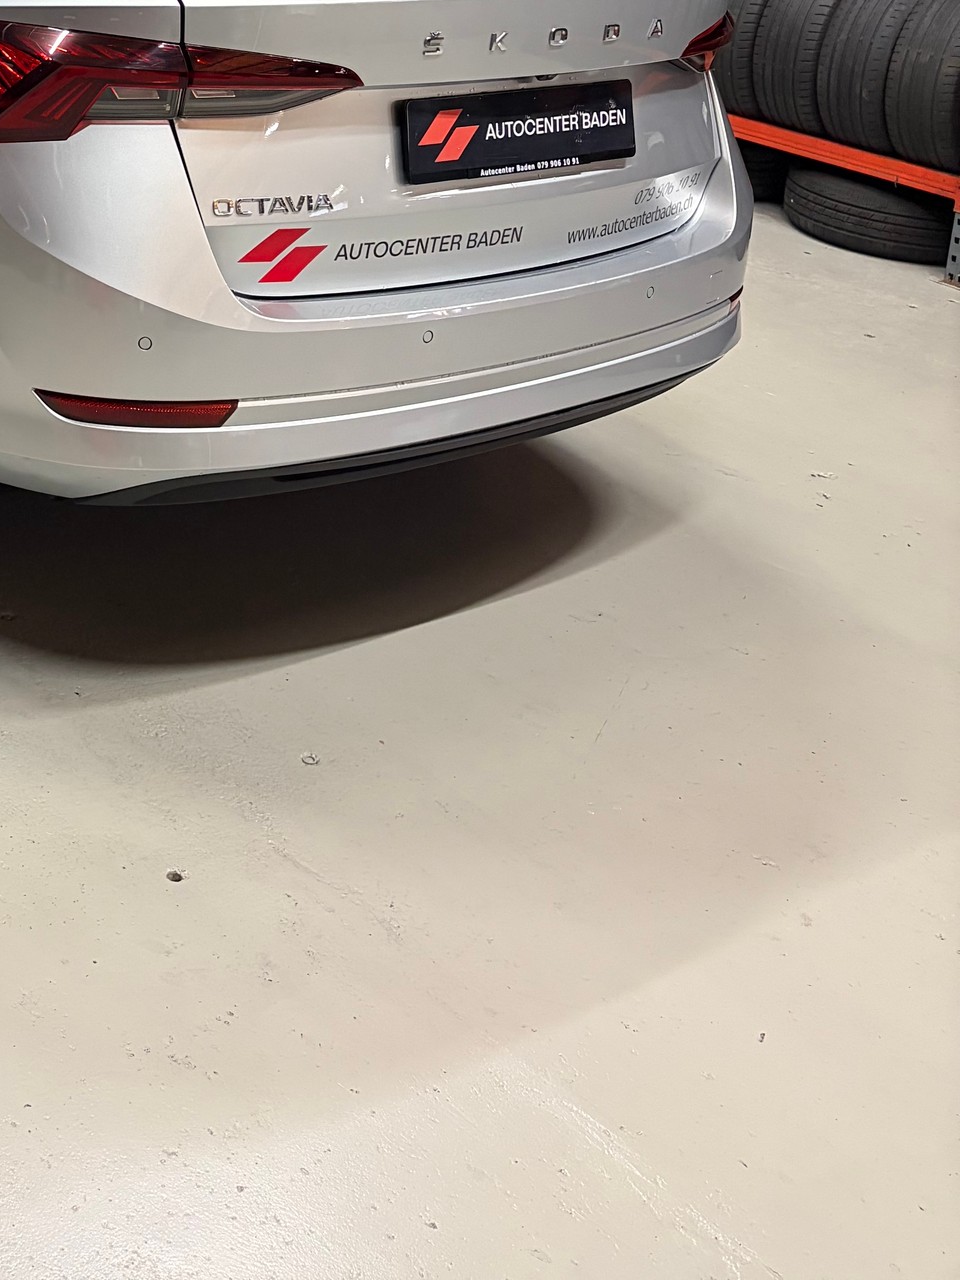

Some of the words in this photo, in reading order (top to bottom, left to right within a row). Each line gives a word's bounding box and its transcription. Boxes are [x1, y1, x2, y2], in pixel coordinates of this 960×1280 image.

[485, 114, 580, 141] AUTOCENTER
[582, 108, 627, 129] BADEN
[480, 165, 515, 177] Autocenter
[516, 163, 536, 172] Baden
[537, 160, 549, 169] 079
[550, 159, 562, 168] 906
[563, 158, 571, 166] 10
[572, 157, 580, 165] 91
[634, 186, 655, 205] 079
[655, 182, 674, 200] 906
[676, 177, 688, 192] 10
[689, 172, 701, 188] 91
[212, 193, 334, 218] OCTAVIA
[567, 194, 694, 244] www.autocenterbaden.ch
[334, 234, 461, 262] AUTOCENTER
[466, 226, 524, 251] BADEN
